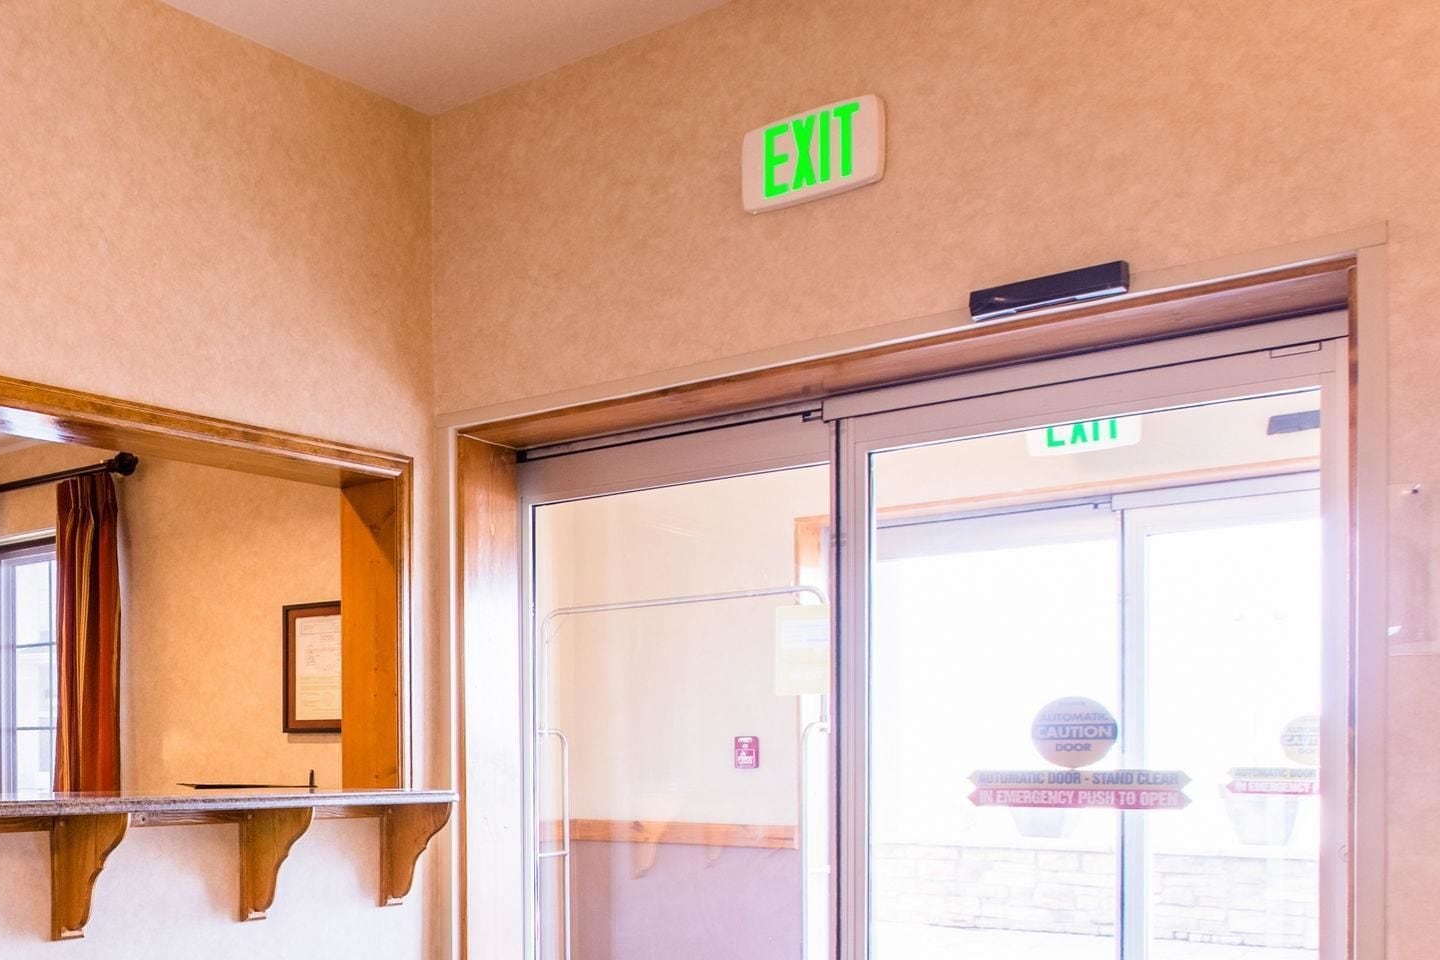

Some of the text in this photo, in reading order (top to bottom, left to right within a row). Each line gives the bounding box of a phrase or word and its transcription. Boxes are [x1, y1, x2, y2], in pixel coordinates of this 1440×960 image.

[762, 100, 861, 199] EXIT
[1039, 712, 1109, 722] AUTOMATIC
[1036, 725, 1113, 738] CAUTION
[1055, 743, 1092, 752] DOOR
[977, 772, 1045, 784] AUTOMATIC
[1048, 772, 1081, 784] DOOR
[1092, 772, 1133, 785] STAND
[1137, 772, 1180, 785] CLEAR
[980, 790, 1179, 806] IN EMERGENCY PUSH TO OPEN
